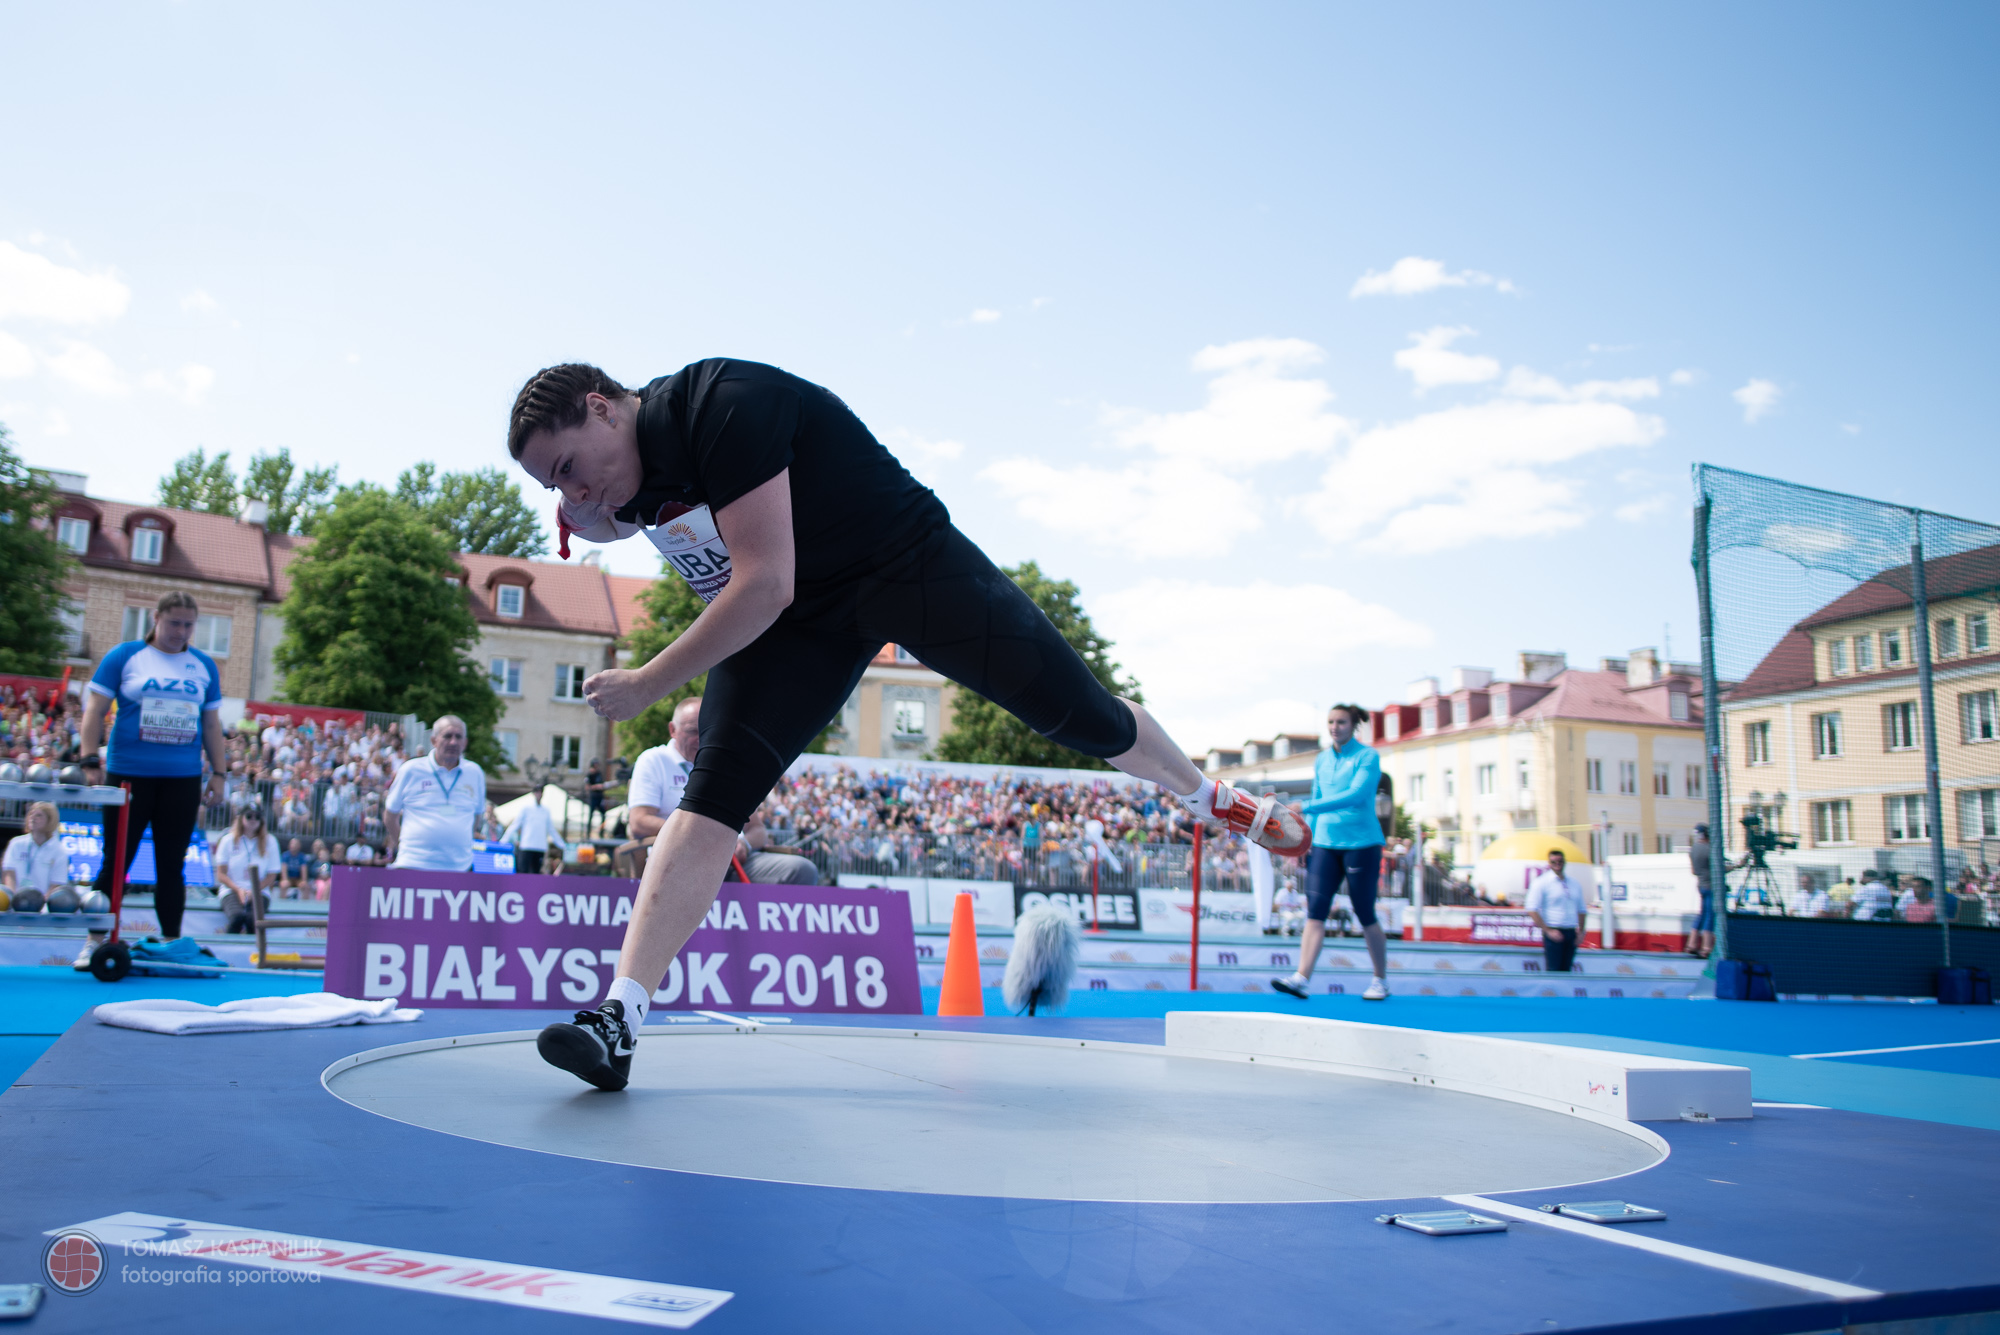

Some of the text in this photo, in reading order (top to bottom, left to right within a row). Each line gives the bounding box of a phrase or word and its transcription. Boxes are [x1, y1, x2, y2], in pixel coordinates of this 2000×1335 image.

[664, 547, 730, 578] UBA
[142, 678, 198, 695] AZS
[62, 836, 104, 856] GUB
[369, 886, 880, 935] MITYNG GWIA NA RYNKU
[1021, 891, 1137, 924] OSHEE
[749, 953, 888, 1008] 2018
